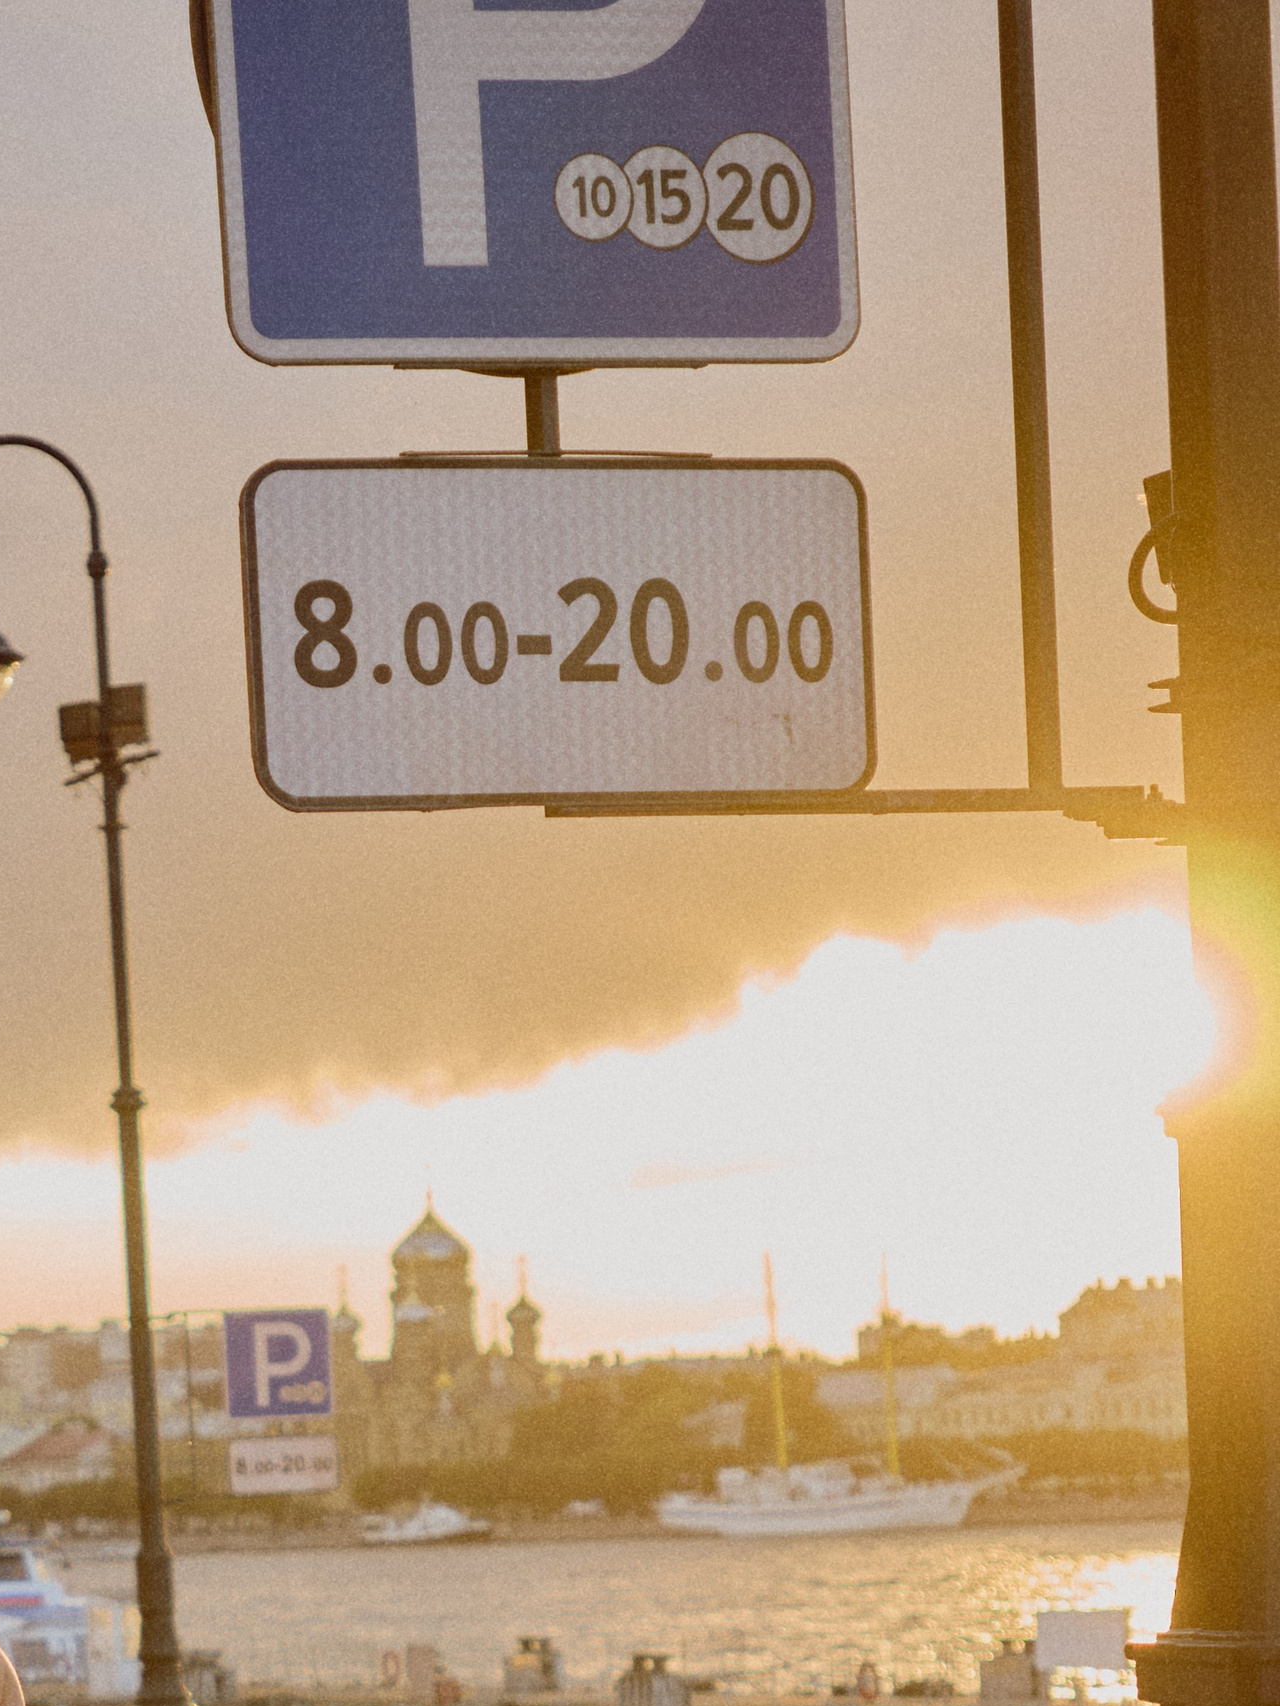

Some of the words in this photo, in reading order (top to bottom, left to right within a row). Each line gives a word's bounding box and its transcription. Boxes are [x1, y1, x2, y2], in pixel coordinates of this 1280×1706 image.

[572, 175, 617, 218] 10
[636, 169, 692, 225] 15
[716, 162, 801, 231] 20
[292, 577, 834, 689] 8.00-20.00
[252, 1320, 312, 1407] P
[236, 1454, 333, 1475] 800-2000
